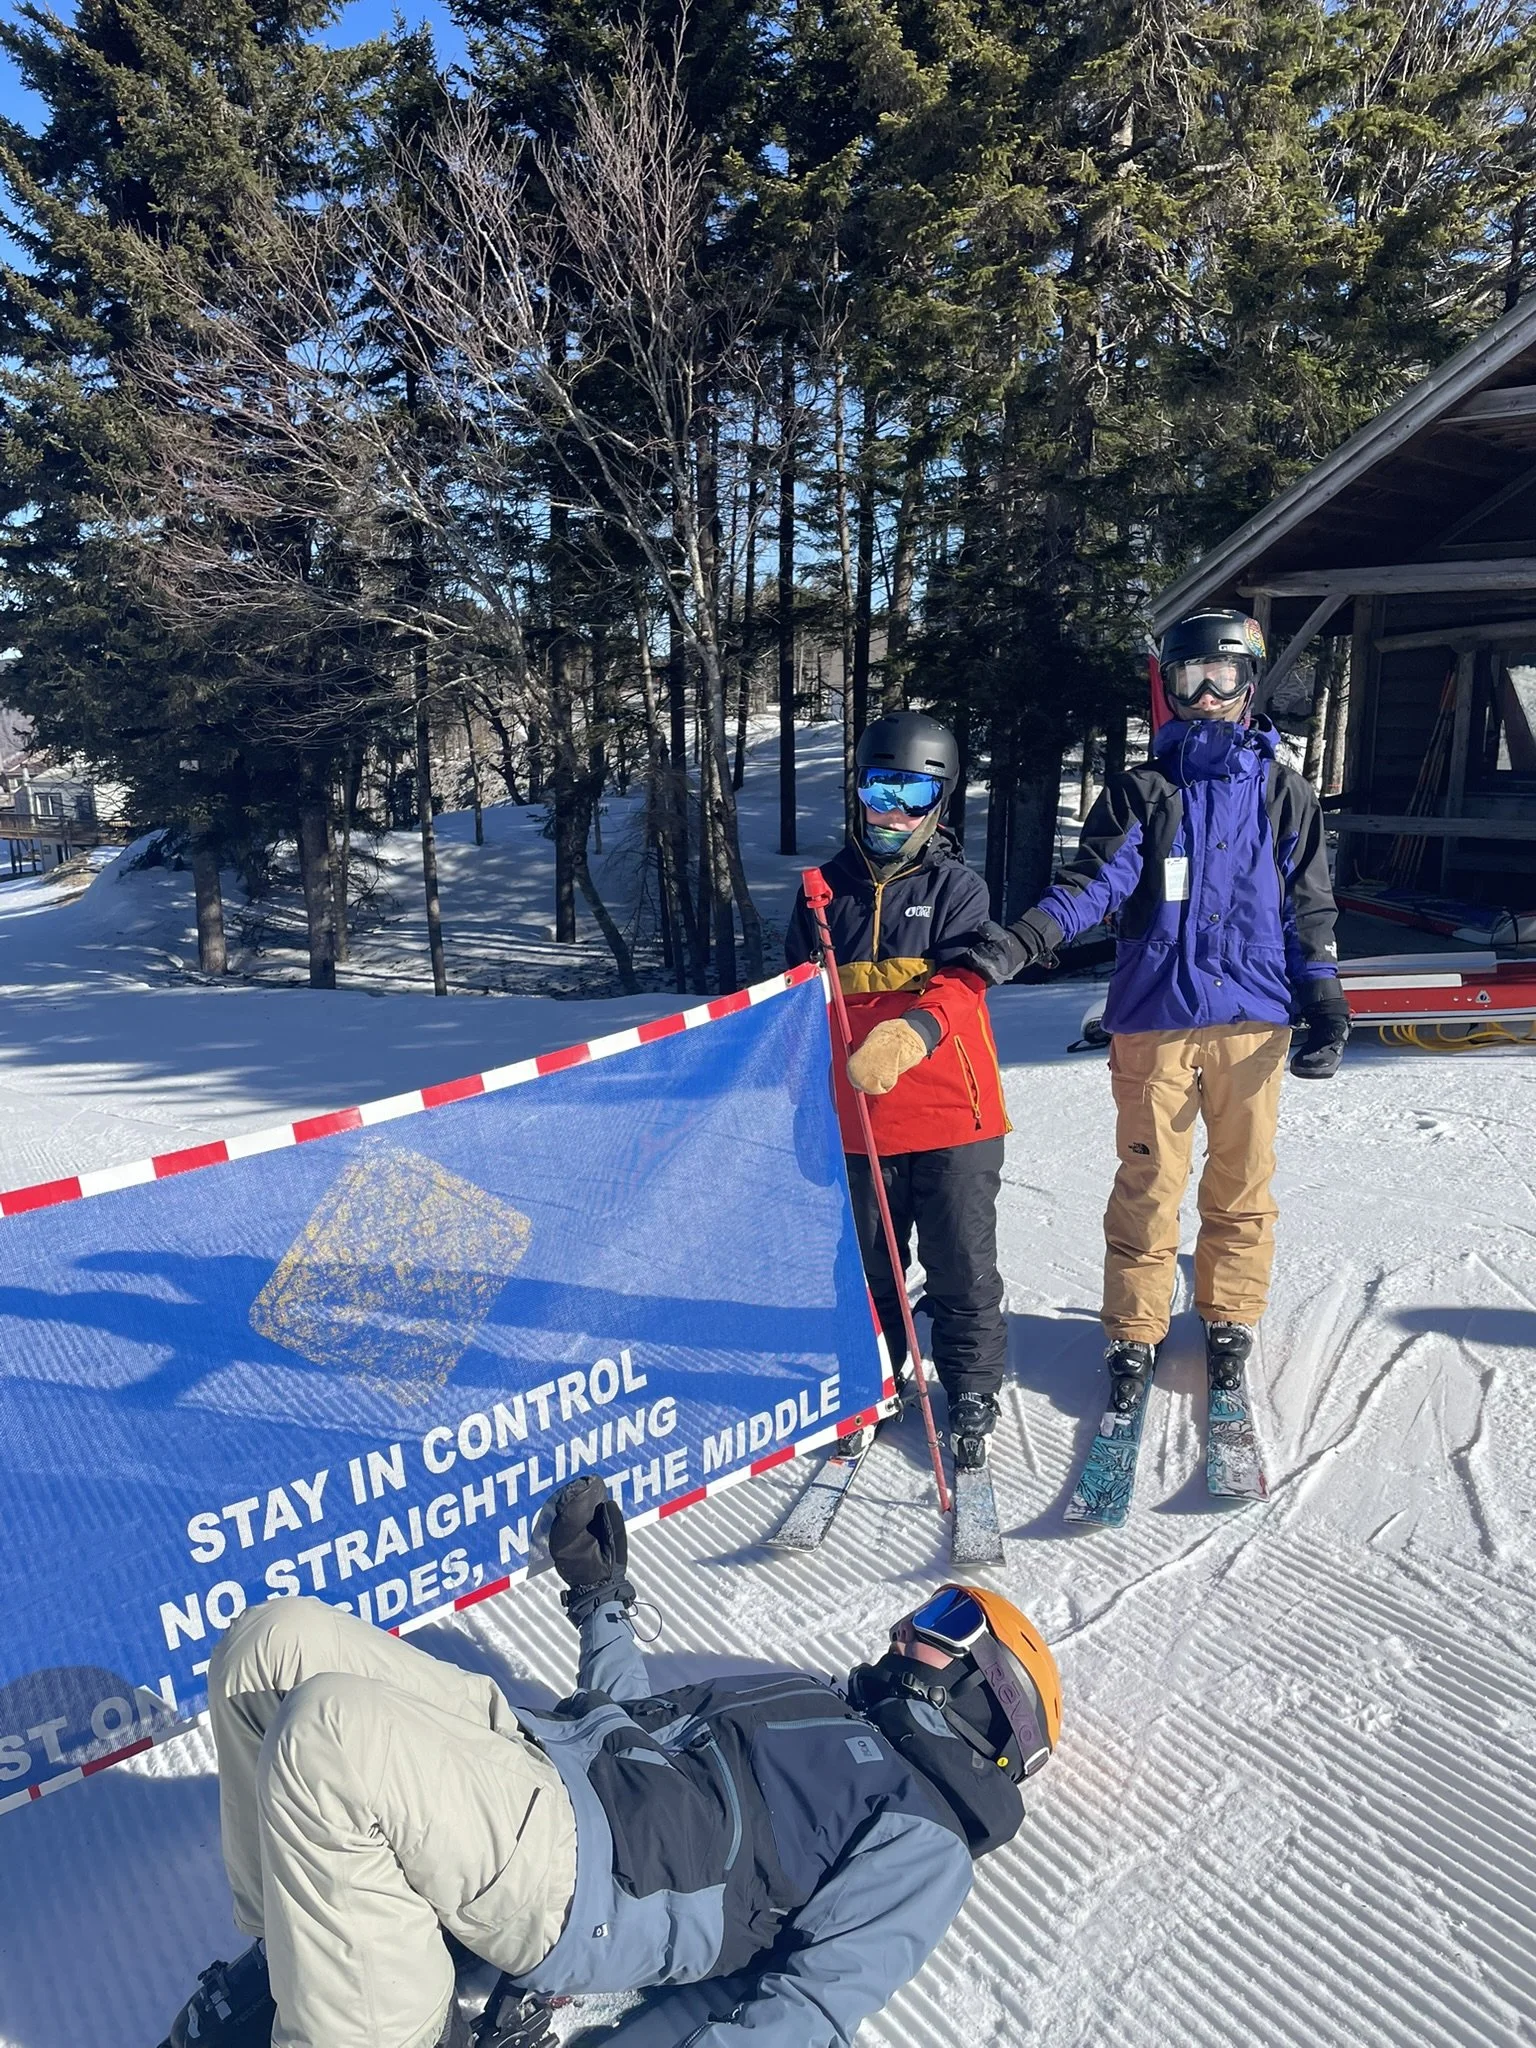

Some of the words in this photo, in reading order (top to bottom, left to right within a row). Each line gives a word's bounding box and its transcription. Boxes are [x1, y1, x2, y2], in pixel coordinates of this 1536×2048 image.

[91, 1673, 178, 1741] ON
[336, 1548, 484, 1625] IDES,
[605, 1446, 689, 1511] THE
[703, 1374, 841, 1475] MIDDLE
[159, 1580, 248, 1651] NO
[264, 1396, 678, 1603] STRAIGHTLINING
[187, 1470, 330, 1563] STAY
[348, 1443, 406, 1504] IN
[422, 1349, 648, 1475] CONTROL
